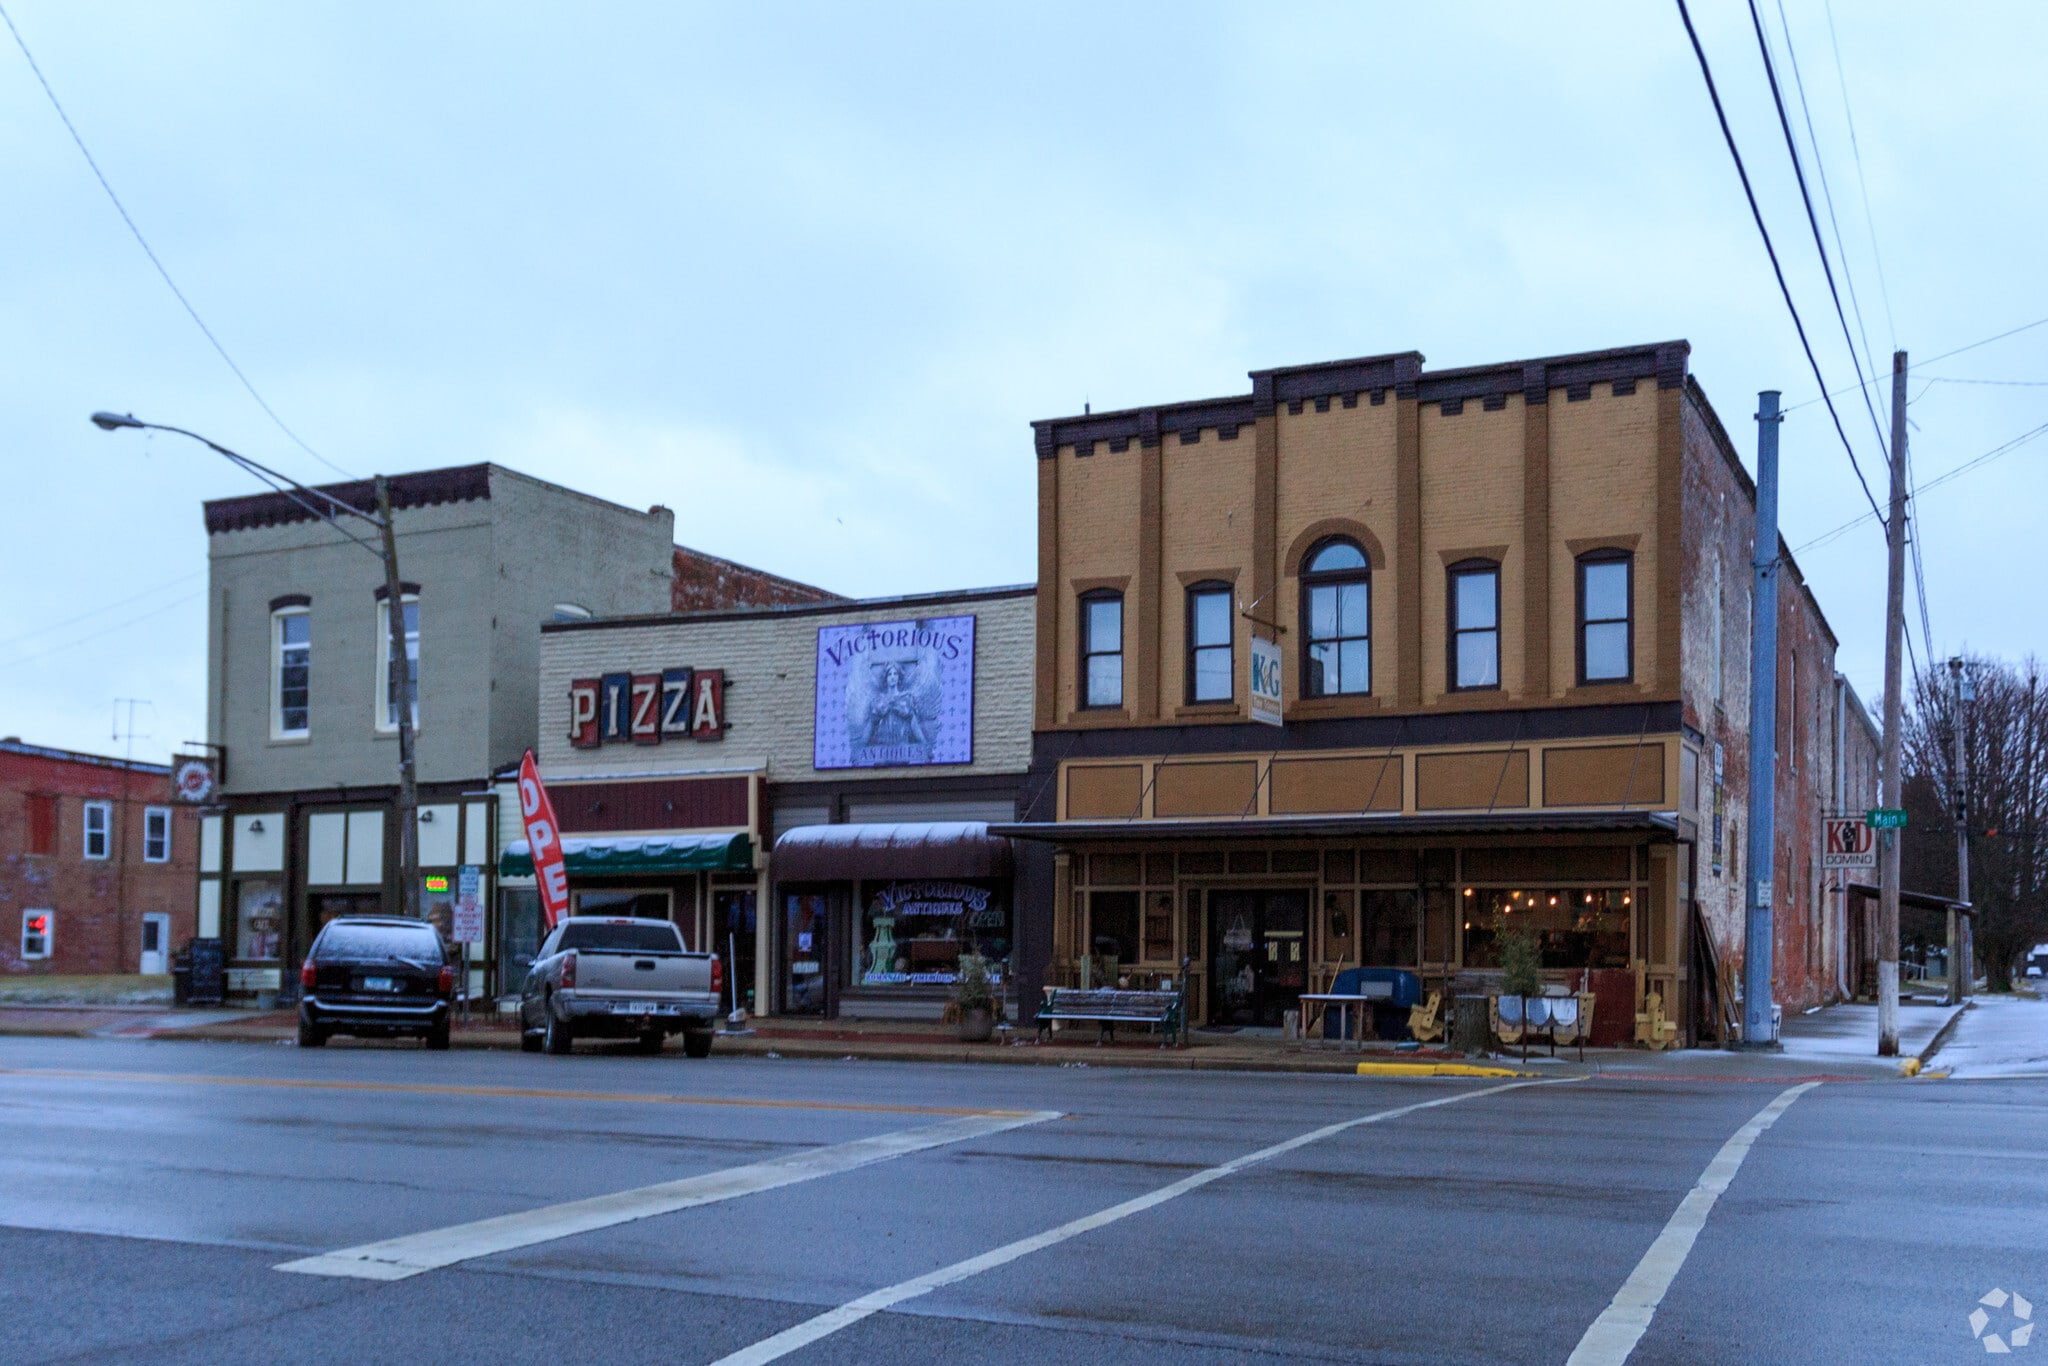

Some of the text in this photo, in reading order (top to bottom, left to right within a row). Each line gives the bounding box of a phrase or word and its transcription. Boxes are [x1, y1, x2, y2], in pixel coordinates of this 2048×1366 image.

[826, 629, 963, 667] VICTORIOUS
[571, 678, 718, 738] PIZZA
[860, 746, 924, 761] ANTIQUES
[1874, 813, 1898, 825] Main
[1825, 854, 1873, 865] DOMINO
[876, 880, 991, 912] VICTORIOUS
[902, 901, 963, 916] ANTIQUES
